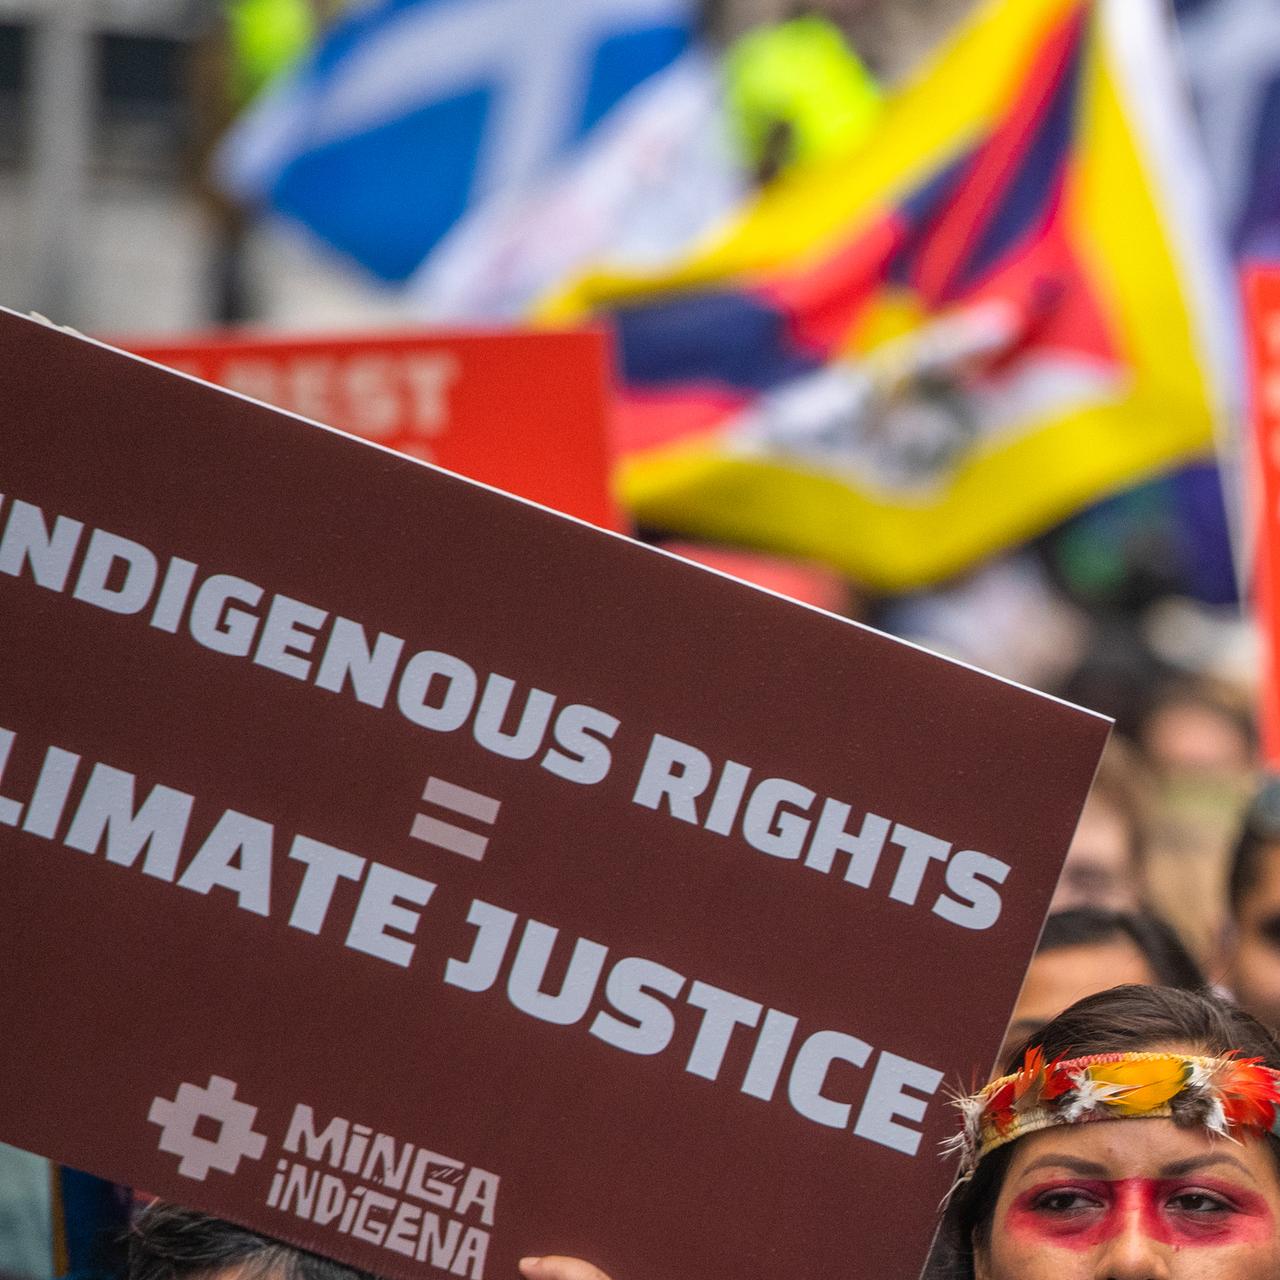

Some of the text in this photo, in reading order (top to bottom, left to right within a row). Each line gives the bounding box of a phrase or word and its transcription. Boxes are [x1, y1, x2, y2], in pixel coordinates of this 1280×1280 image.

[0, 492, 1012, 931] NDIGENOUS RIGHTS
[443, 898, 945, 1157] JUSTICE
